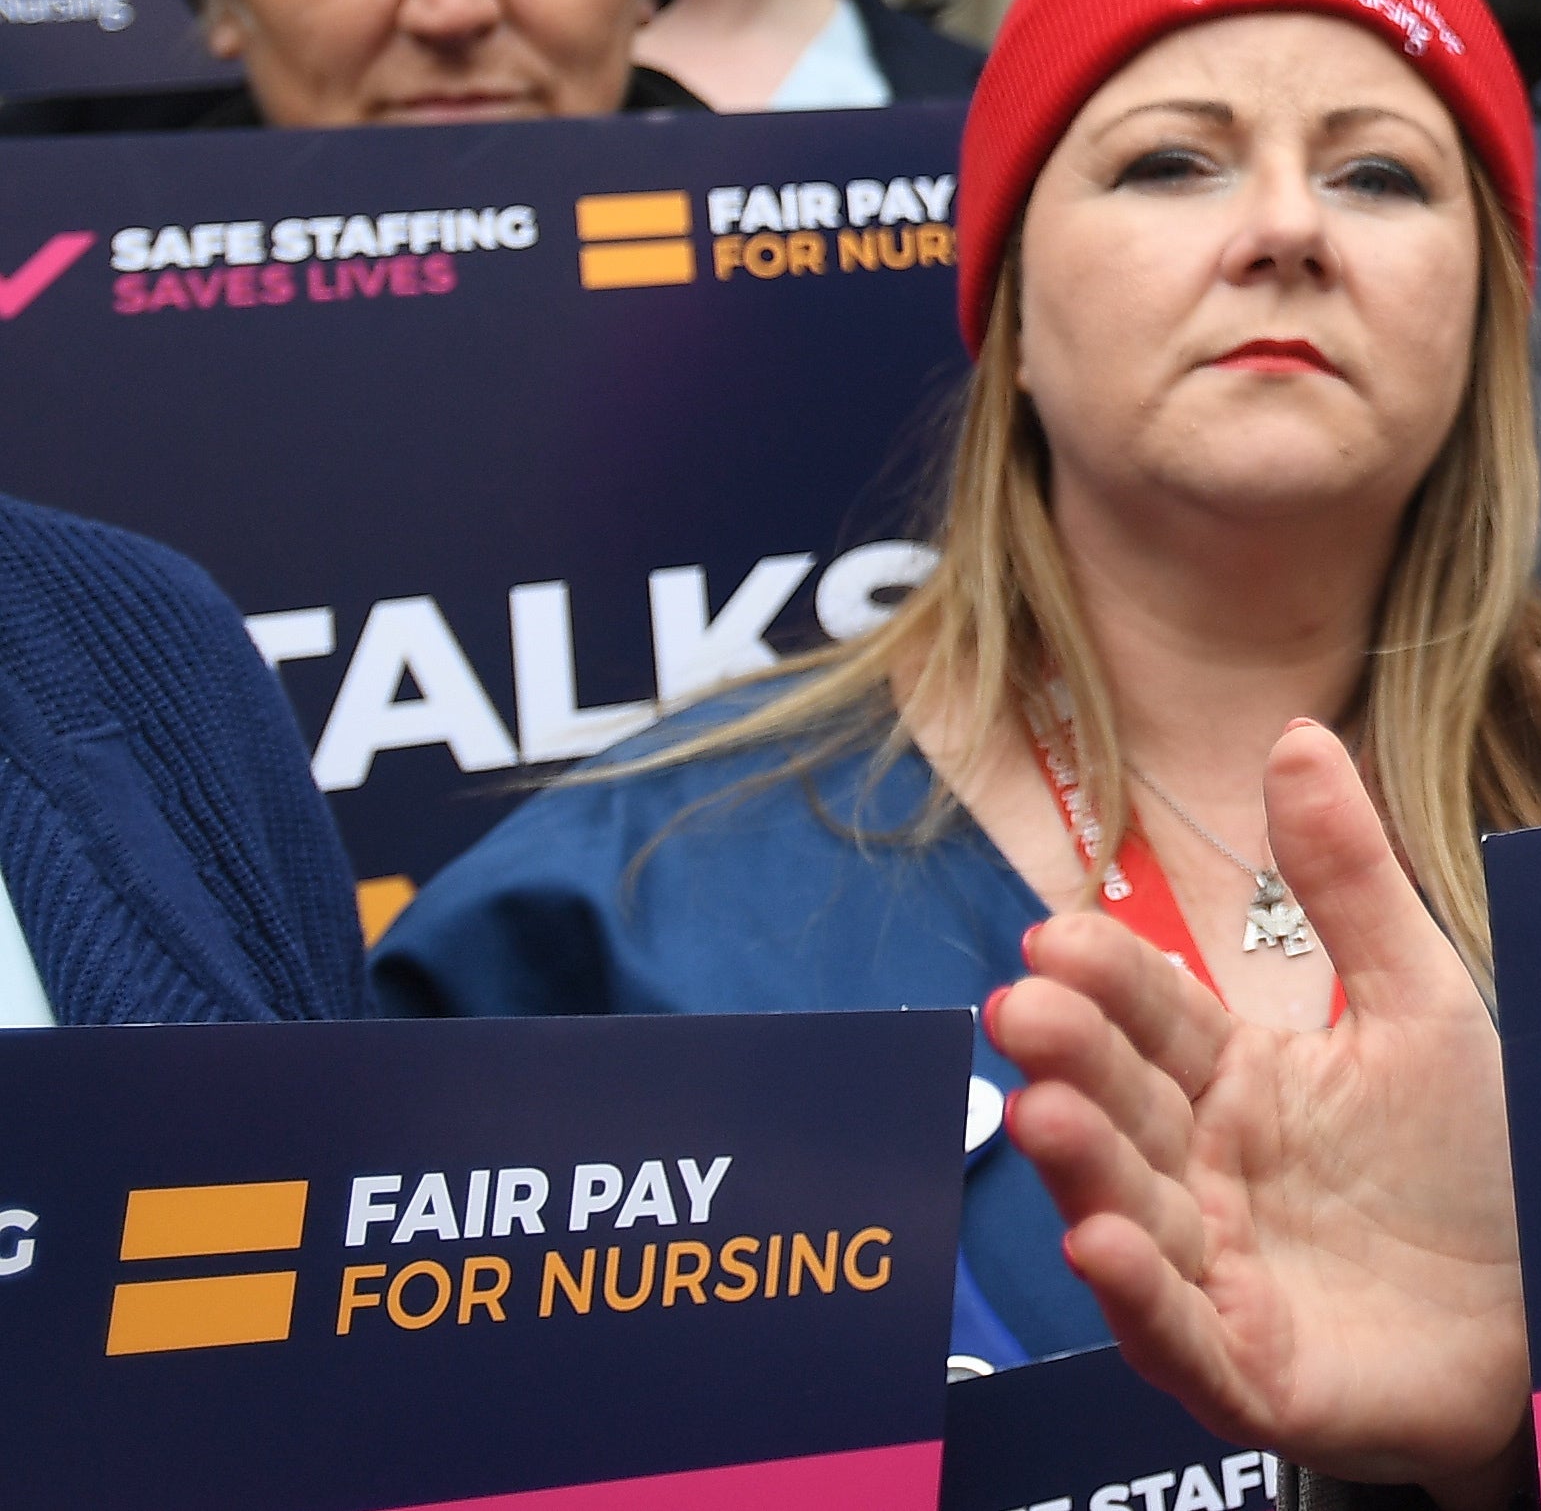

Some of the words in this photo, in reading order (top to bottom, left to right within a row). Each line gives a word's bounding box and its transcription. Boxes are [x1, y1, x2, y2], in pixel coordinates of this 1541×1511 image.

[109, 219, 268, 273] SAFE
[269, 194, 540, 263] STAFFING
[705, 180, 846, 236] FAIR
[845, 172, 958, 228] PAY
[111, 261, 297, 316] SAVES
[306, 251, 459, 303] LIVES
[712, 230, 828, 283] FOR
[837, 220, 962, 273] NUR
[343, 1169, 547, 1248] FAIR
[567, 1155, 734, 1233] PAY
[334, 1256, 513, 1337] FOR
[538, 1225, 894, 1319] NURSING
